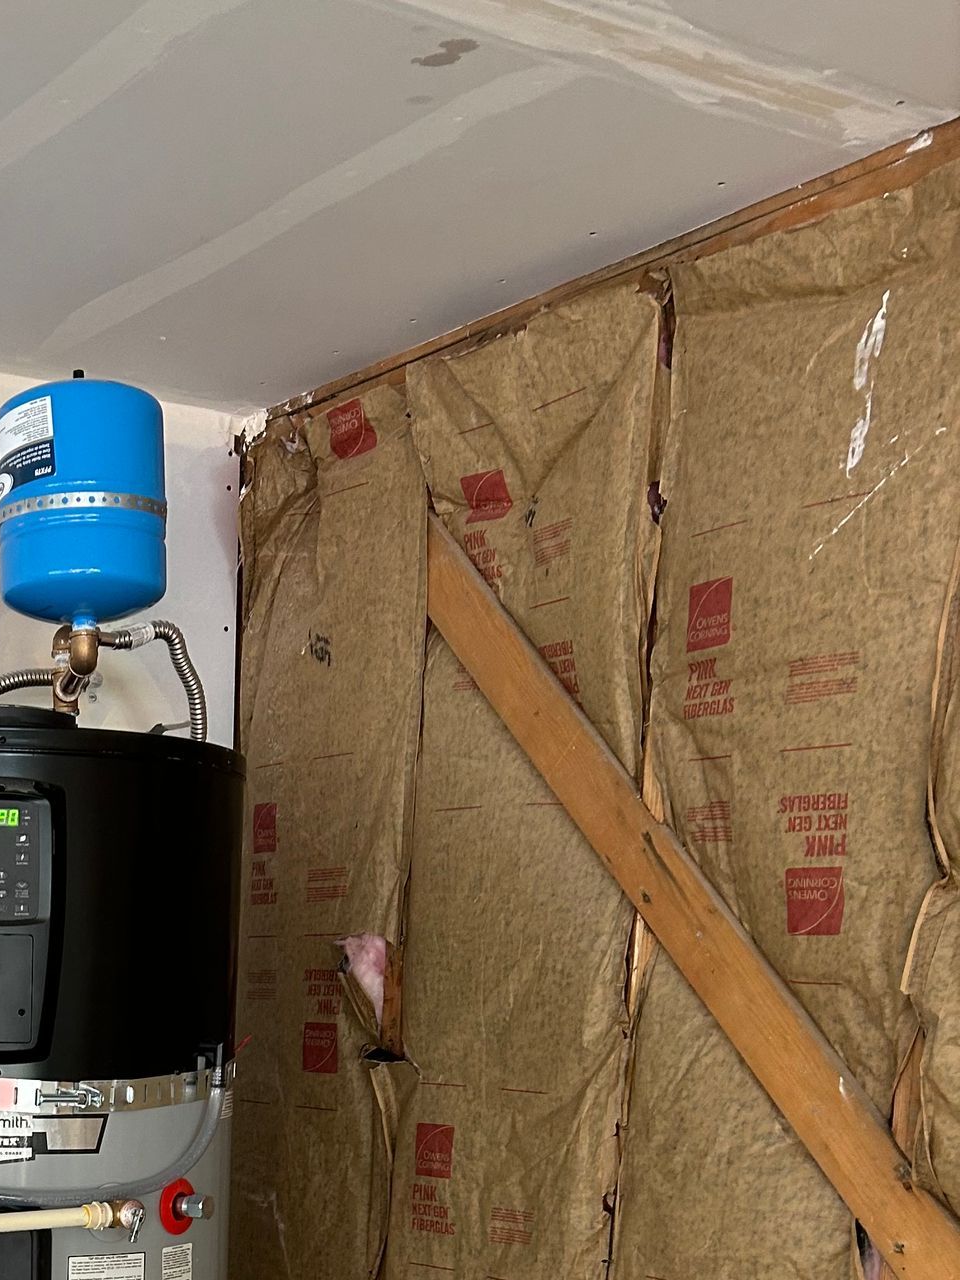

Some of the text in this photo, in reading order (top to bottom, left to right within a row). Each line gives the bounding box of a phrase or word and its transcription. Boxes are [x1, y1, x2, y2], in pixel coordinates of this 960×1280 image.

[464, 529, 487, 550] PINK
[696, 613, 728, 629] OWENS
[690, 626, 728, 641] CORNING
[688, 658, 717, 682] PINK
[685, 680, 732, 701] NEXT GEN
[683, 698, 735, 720] FIBERGLAS
[780, 793, 849, 814] FIBERGLAS
[788, 814, 847, 833] NEXT GEN
[804, 834, 847, 857] PINK
[788, 878, 838, 889] CORNING
[788, 890, 828, 901] OWENS
[413, 1184, 437, 1202] PINK
[412, 1202, 431, 1216] NEXT
[412, 1218, 455, 1235] FIBERGLAS
